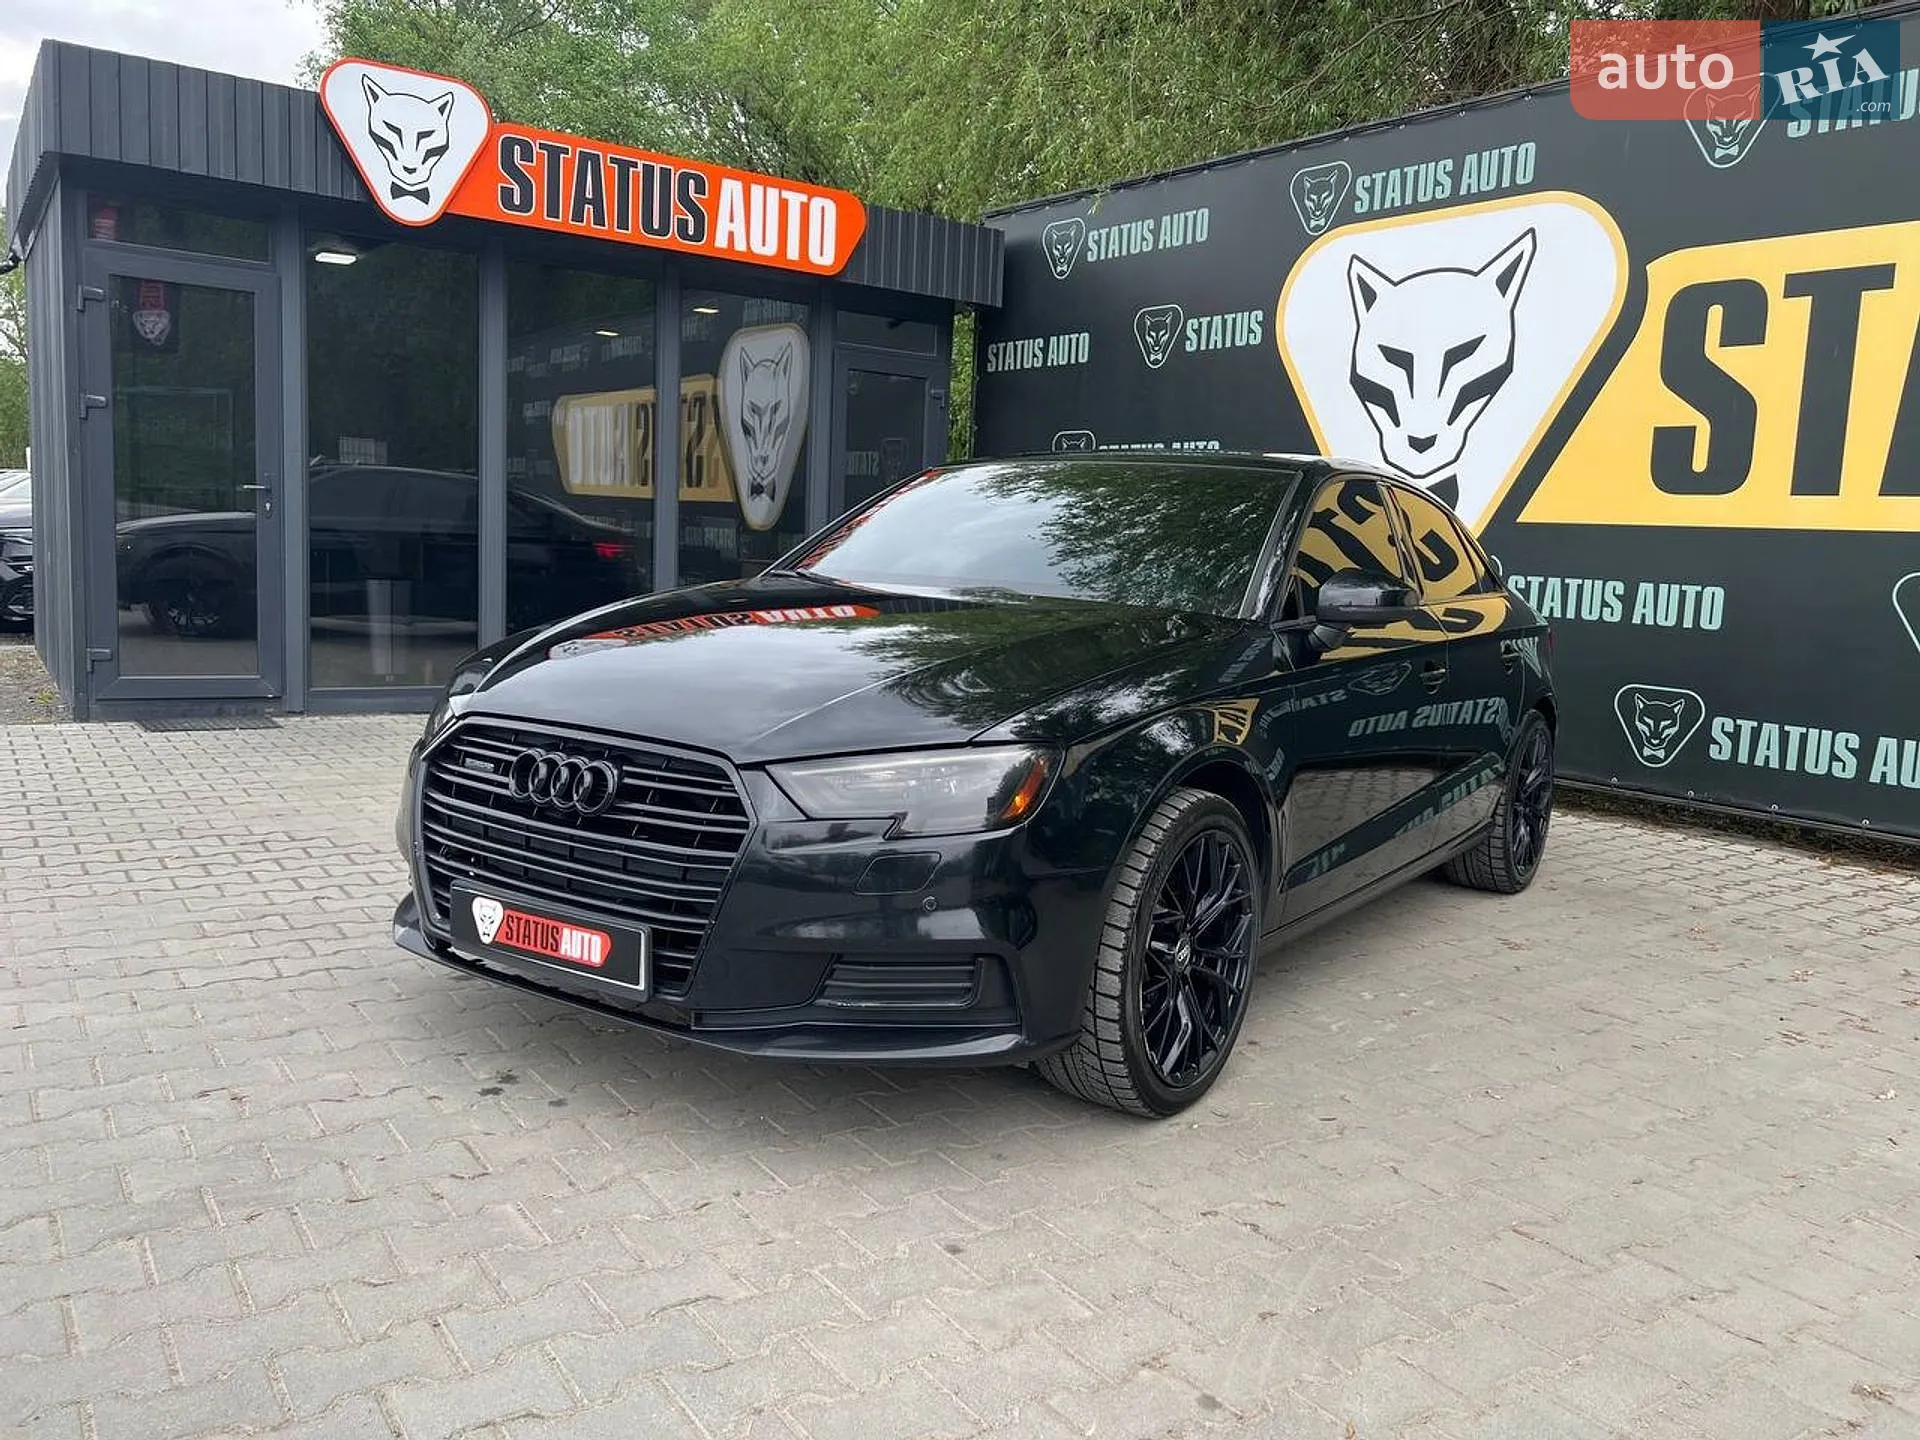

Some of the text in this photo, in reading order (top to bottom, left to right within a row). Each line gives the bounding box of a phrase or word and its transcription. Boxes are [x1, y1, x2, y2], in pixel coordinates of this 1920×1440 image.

[498, 133, 837, 267] STATUS AUTO
[1354, 142, 1537, 214] STATUS AUTO
[1086, 208, 1210, 262] STATUS AUTO
[987, 332, 1090, 372] STATUS AUTO
[1185, 310, 1263, 352] STATUS
[1650, 262, 1920, 496] ST
[1632, 582, 1725, 631] AUTO
[1708, 716, 1860, 780] STATUS
[505, 915, 602, 965] STATUS AUTO
